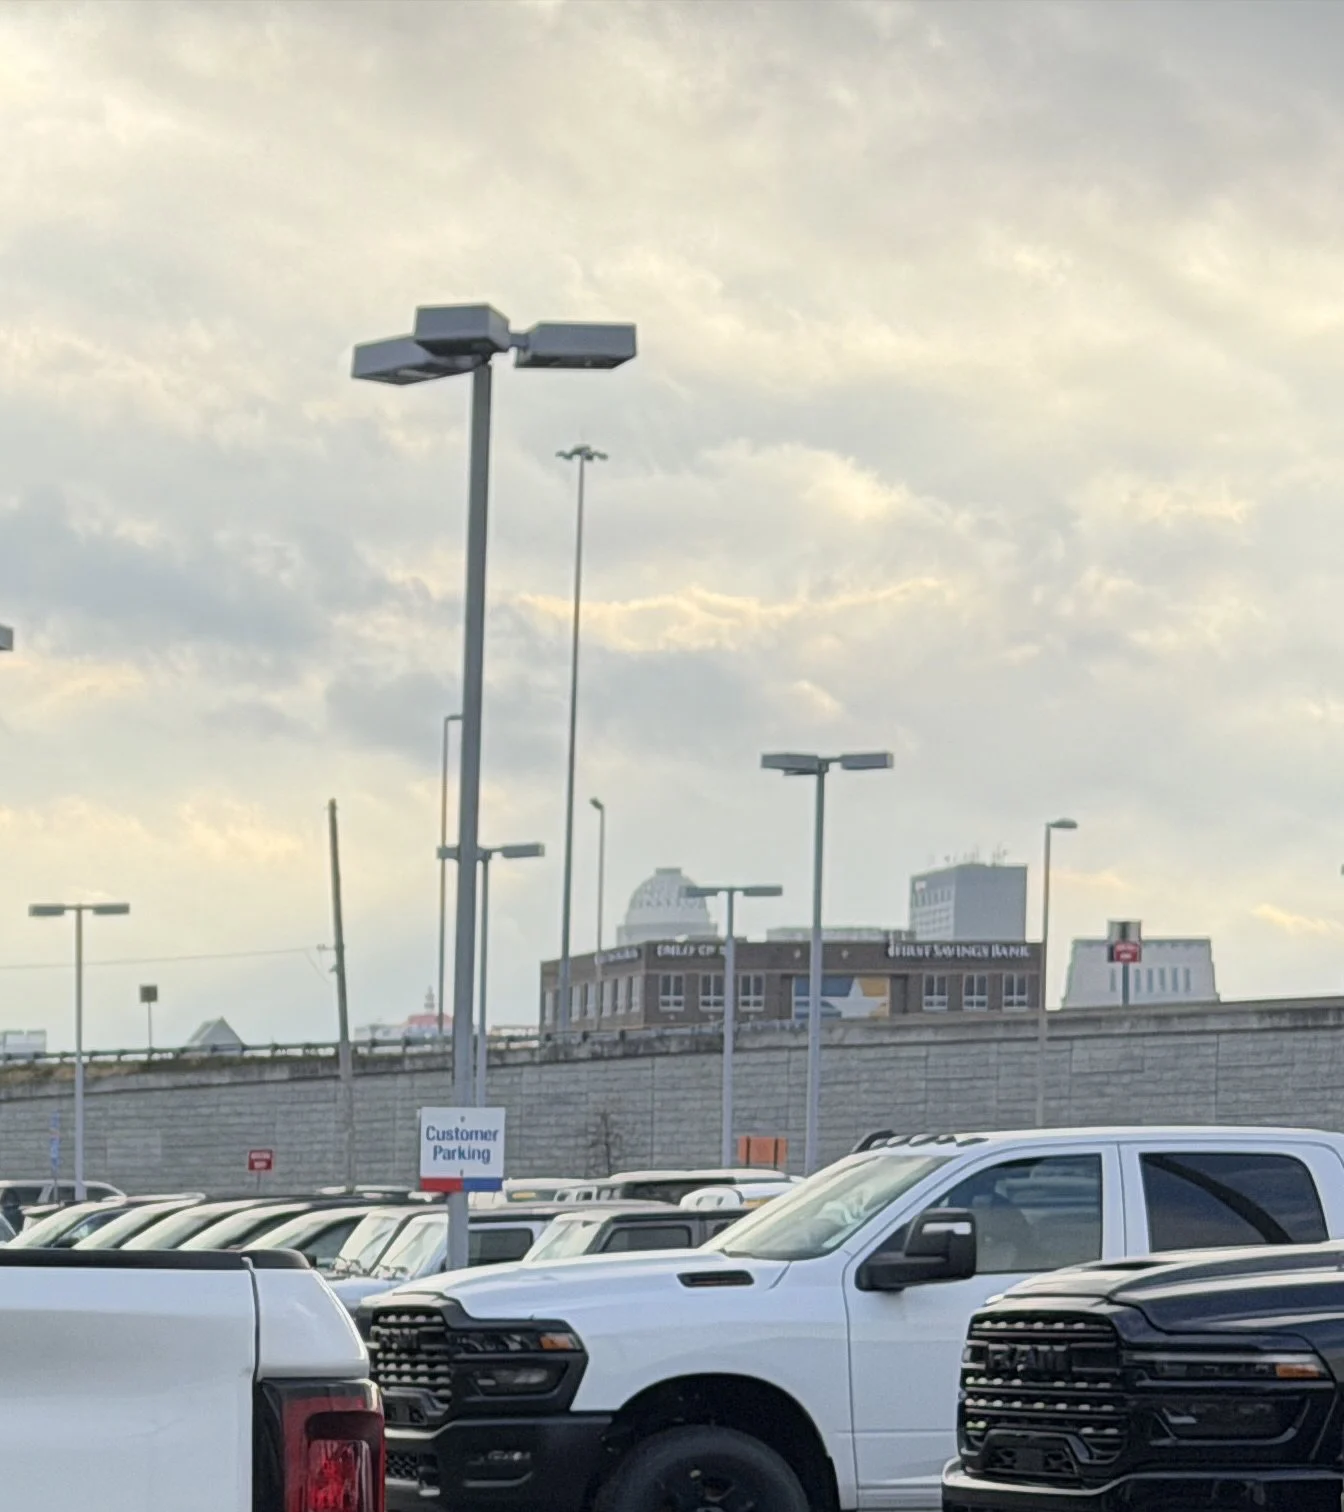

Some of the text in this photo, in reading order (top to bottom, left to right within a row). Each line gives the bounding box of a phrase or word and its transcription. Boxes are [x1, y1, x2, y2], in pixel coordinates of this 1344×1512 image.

[933, 943, 989, 958] SAVINGS
[991, 943, 1030, 958] BANK
[425, 1125, 499, 1142] Customer
[432, 1144, 491, 1165] Parking
[986, 1343, 1071, 1373] RAM
